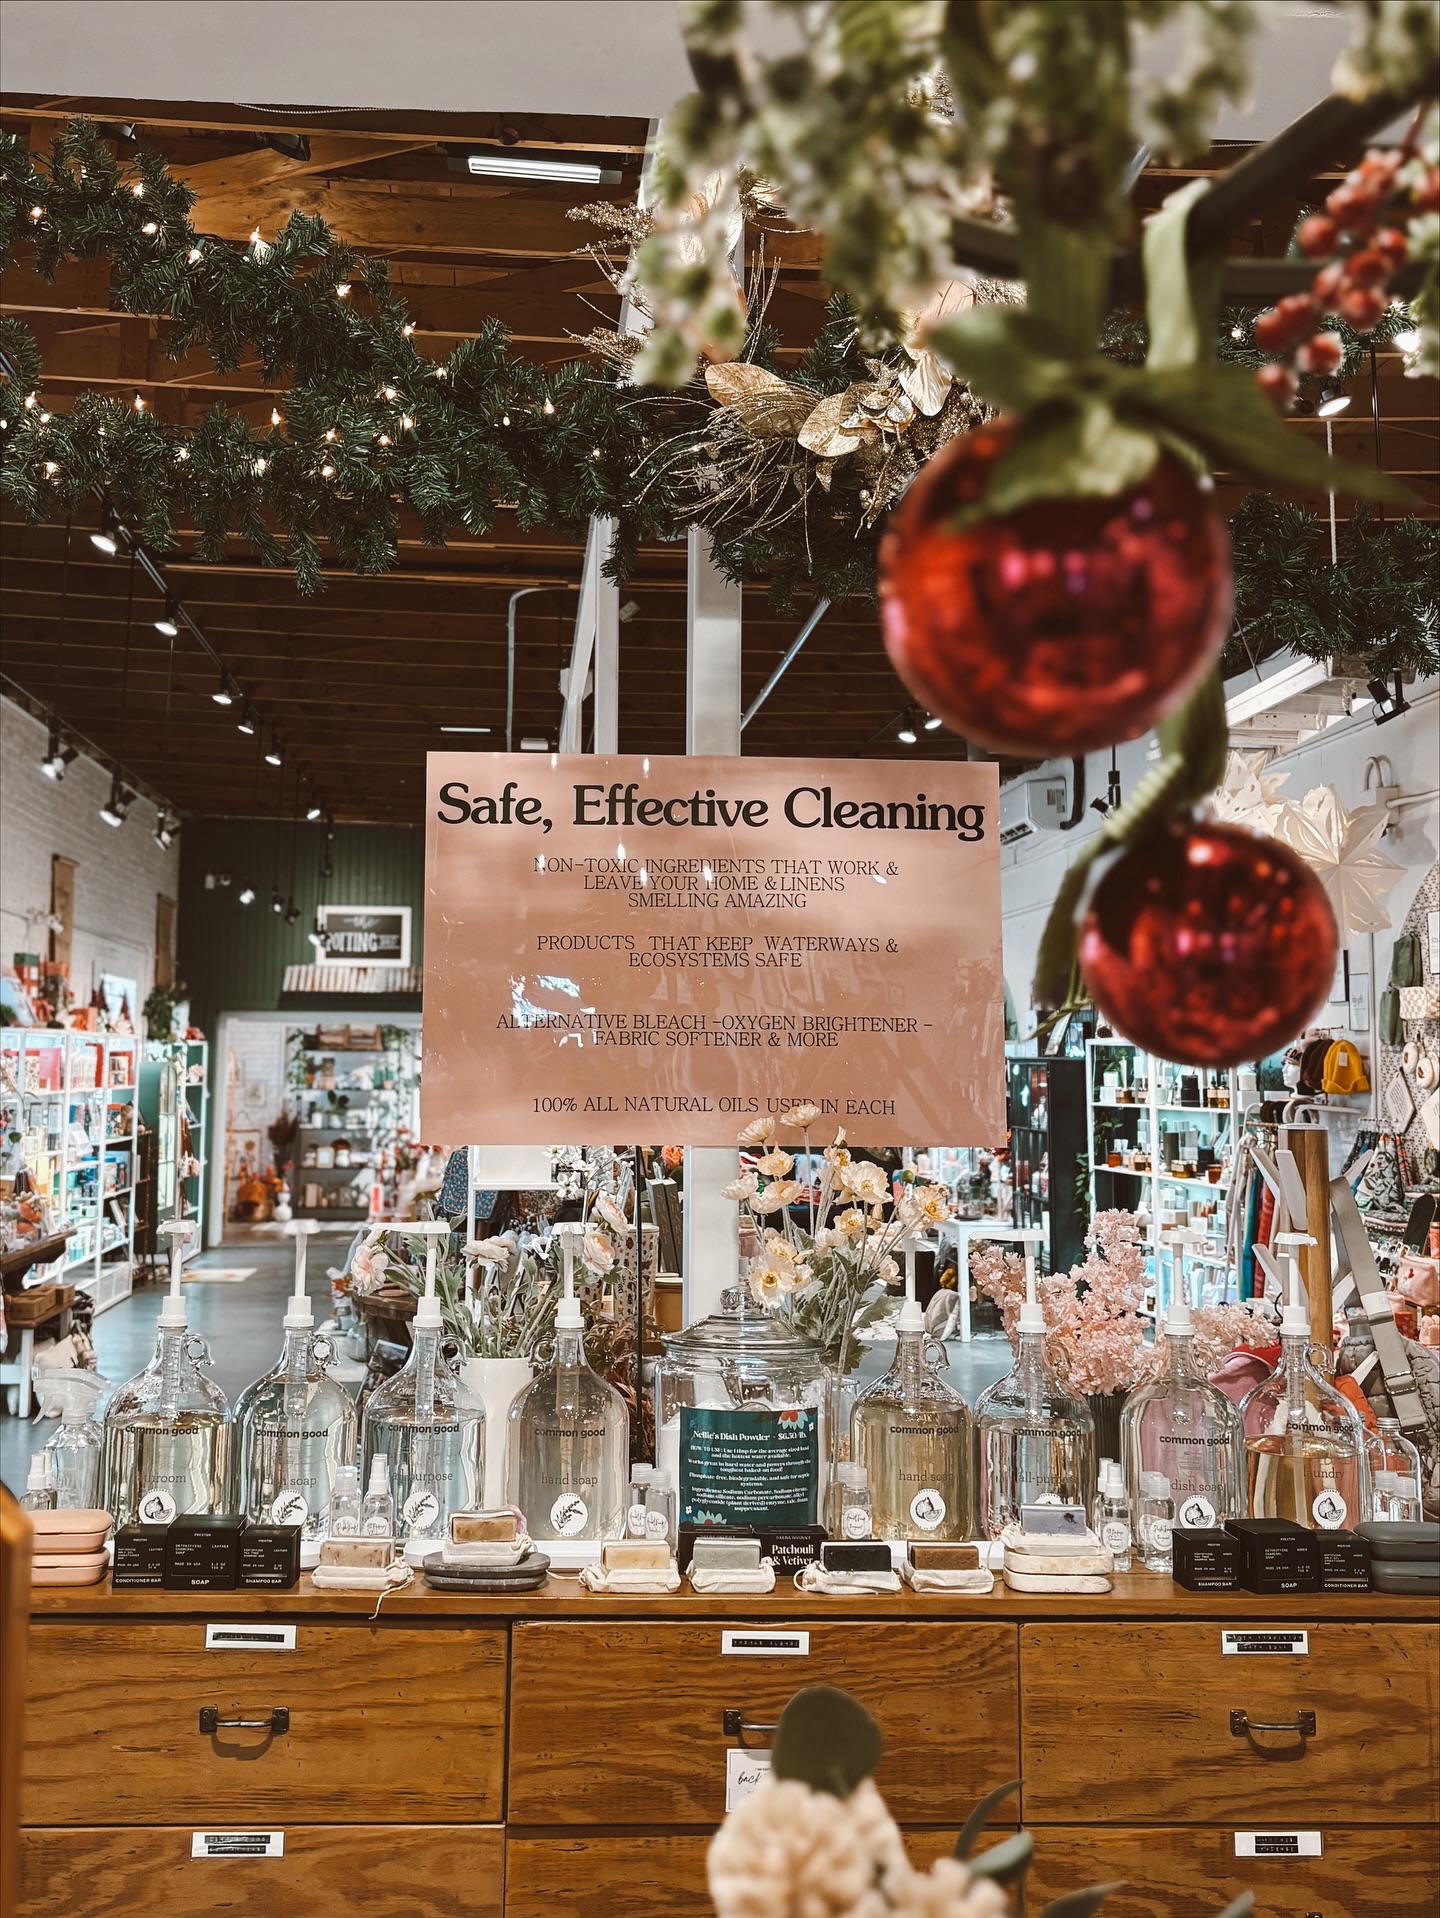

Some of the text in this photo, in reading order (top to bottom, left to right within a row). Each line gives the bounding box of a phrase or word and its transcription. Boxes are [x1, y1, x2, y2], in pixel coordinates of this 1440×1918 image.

[437, 781, 986, 842] Safe, Effective Cleaning
[644, 857, 766, 875] INGREDIENTS
[770, 859, 823, 875] THAT
[826, 860, 881, 876] WORK
[885, 860, 900, 876] &
[583, 874, 845, 892] LEAVE YOUR HOME & LINENS
[628, 892, 807, 909] SMELLING AMAZING
[536, 934, 899, 954] PRODUCTS THAT KEEP WATERWAYS &
[628, 951, 803, 968] ECOSYSTEMS SAFE
[496, 1013, 628, 1030] ALTERNATIVE
[632, 1014, 707, 1030] BLEACH
[802, 1015, 919, 1033] BRIGHTENER
[594, 1029, 839, 1048] FABRIC SOFTENER & MORE
[532, 1096, 578, 1113] 100%
[582, 1096, 620, 1112] ALL
[624, 1096, 714, 1113] NATURAL
[718, 1096, 759, 1113] OILS
[820, 1098, 839, 1114] IN
[845, 1099, 896, 1116] EACH
[125, 1425, 199, 1437] common good
[387, 1423, 460, 1435] common good
[534, 1427, 606, 1439] common good
[889, 1425, 960, 1436] common good
[1012, 1427, 1082, 1438] common good
[1286, 1421, 1355, 1433] common good
[255, 1428, 329, 1440] common good
[694, 1430, 720, 1440] Nellie's
[720, 1432, 738, 1441] Dish
[739, 1433, 770, 1441] Powder
[1159, 1435, 1231, 1447] common good
[541, 1471, 599, 1488] hand soap
[898, 1468, 928, 1482] hand
[290, 1477, 318, 1489] soap
[1171, 1478, 1225, 1495] dish soap
[771, 1544, 814, 1555] Patchouli
[773, 1555, 813, 1566] & Vetiver
